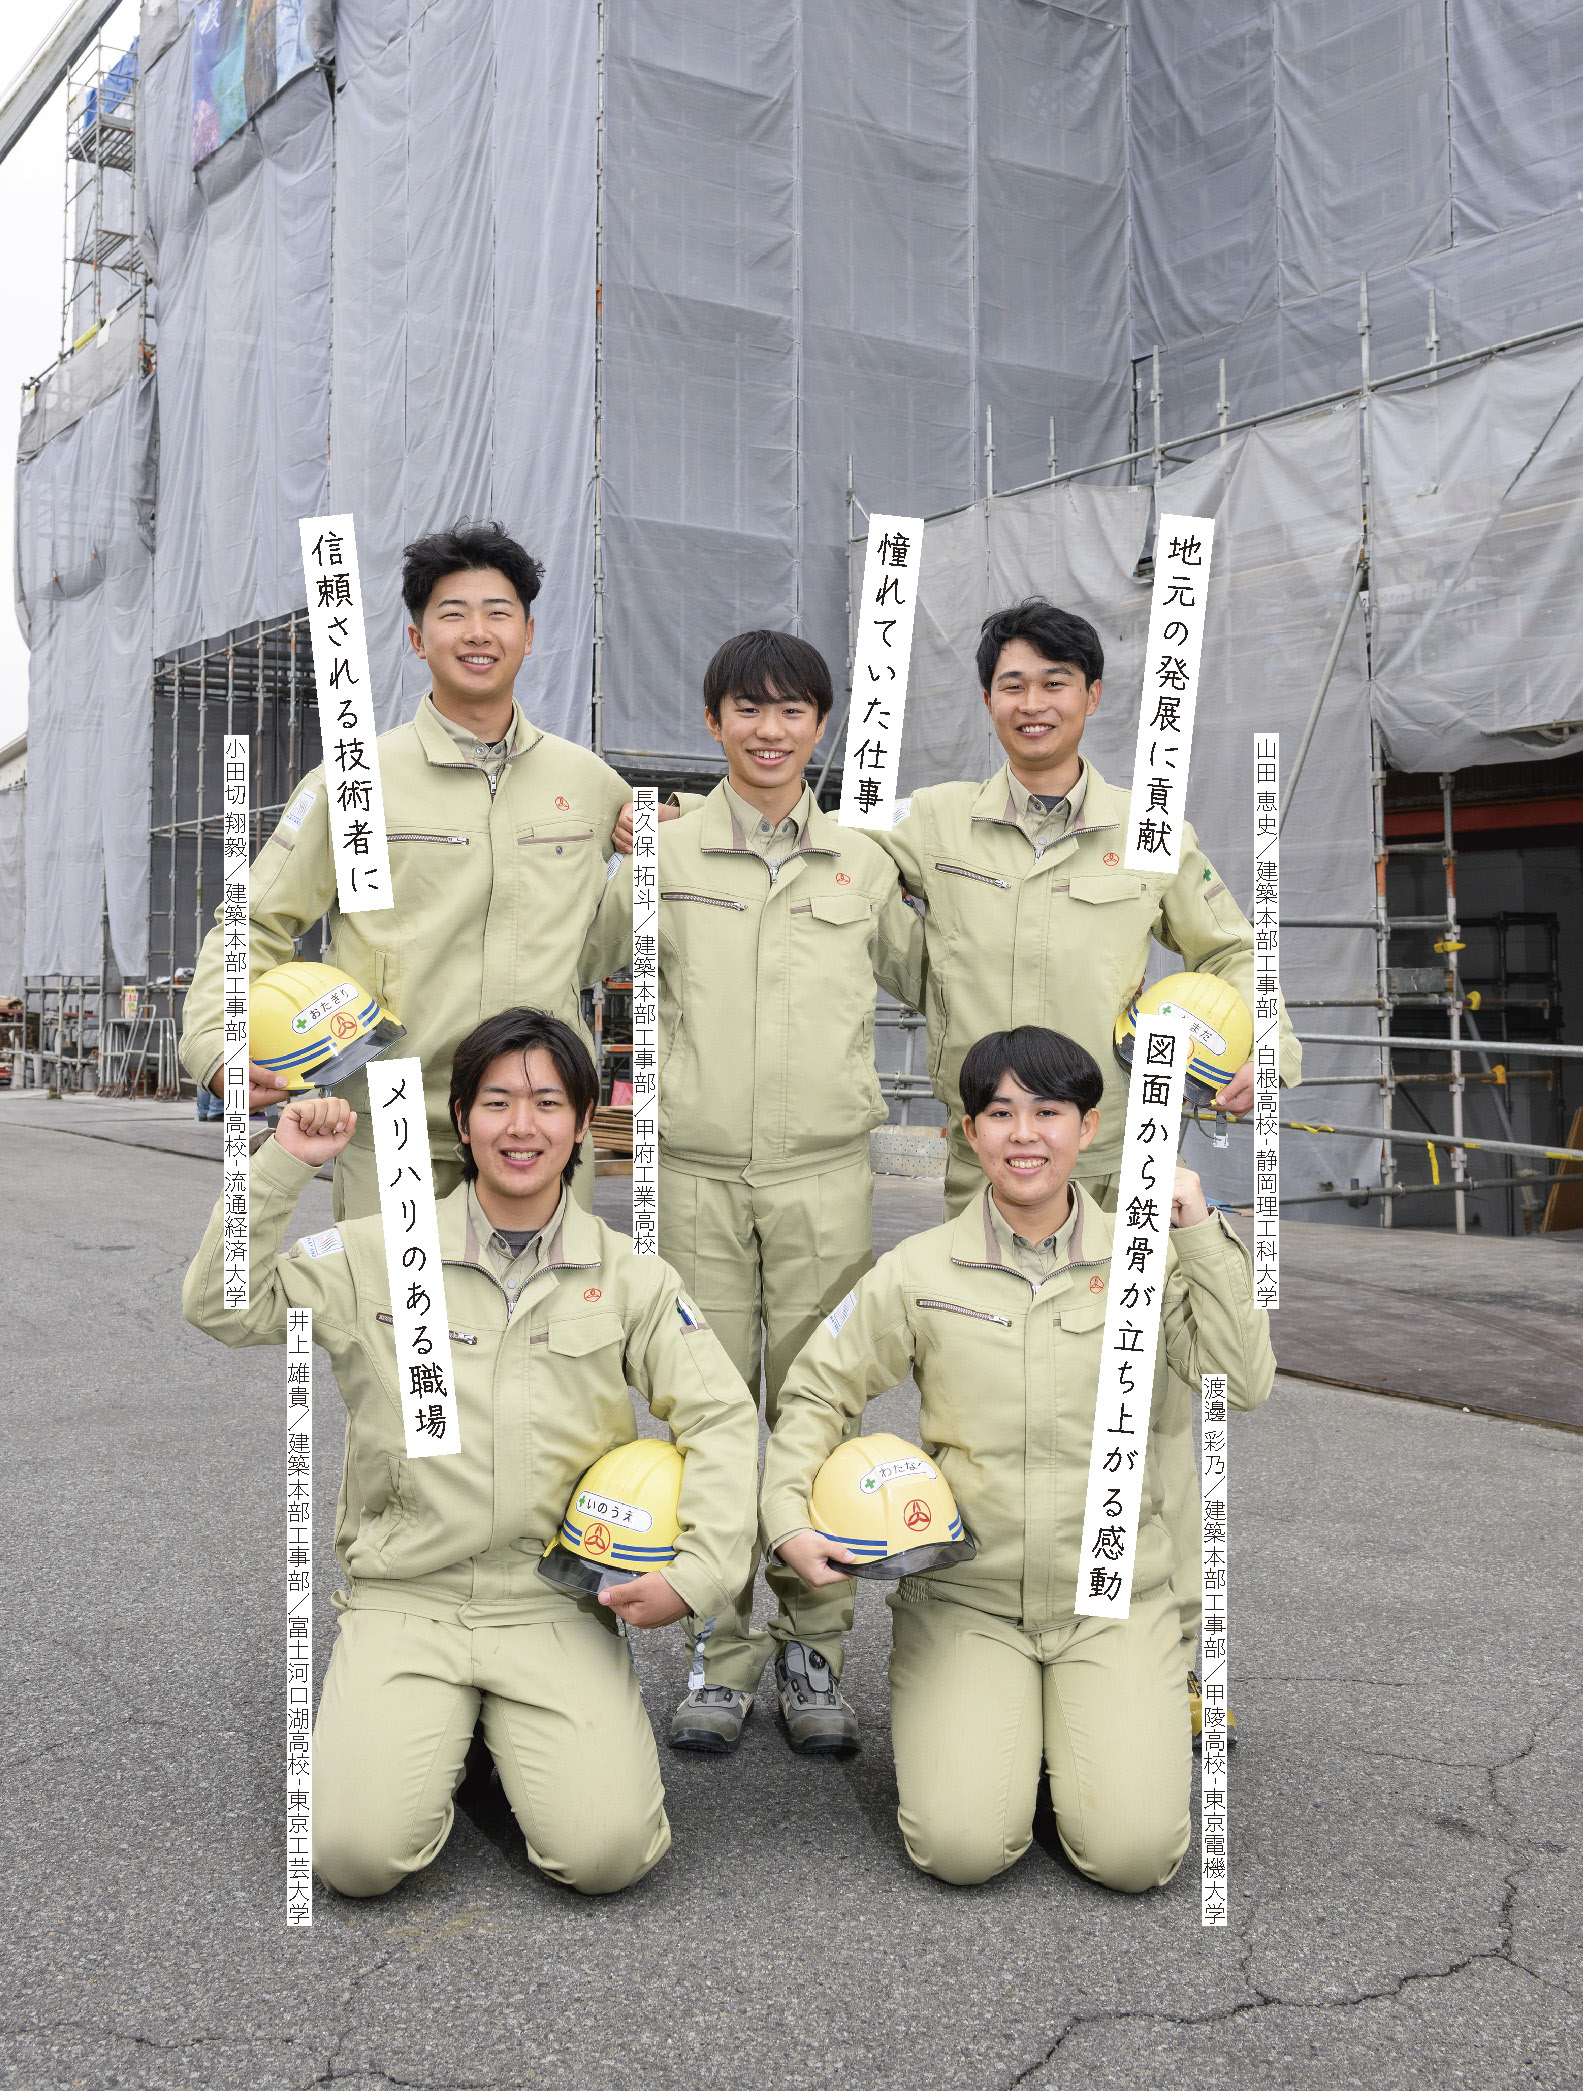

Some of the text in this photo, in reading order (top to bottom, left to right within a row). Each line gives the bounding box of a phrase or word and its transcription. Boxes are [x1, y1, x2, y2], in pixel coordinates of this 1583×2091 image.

[309, 988, 349, 1020] おたぎり
[879, 1461, 922, 1478] わたな
[586, 1498, 634, 1523] いのうえ
